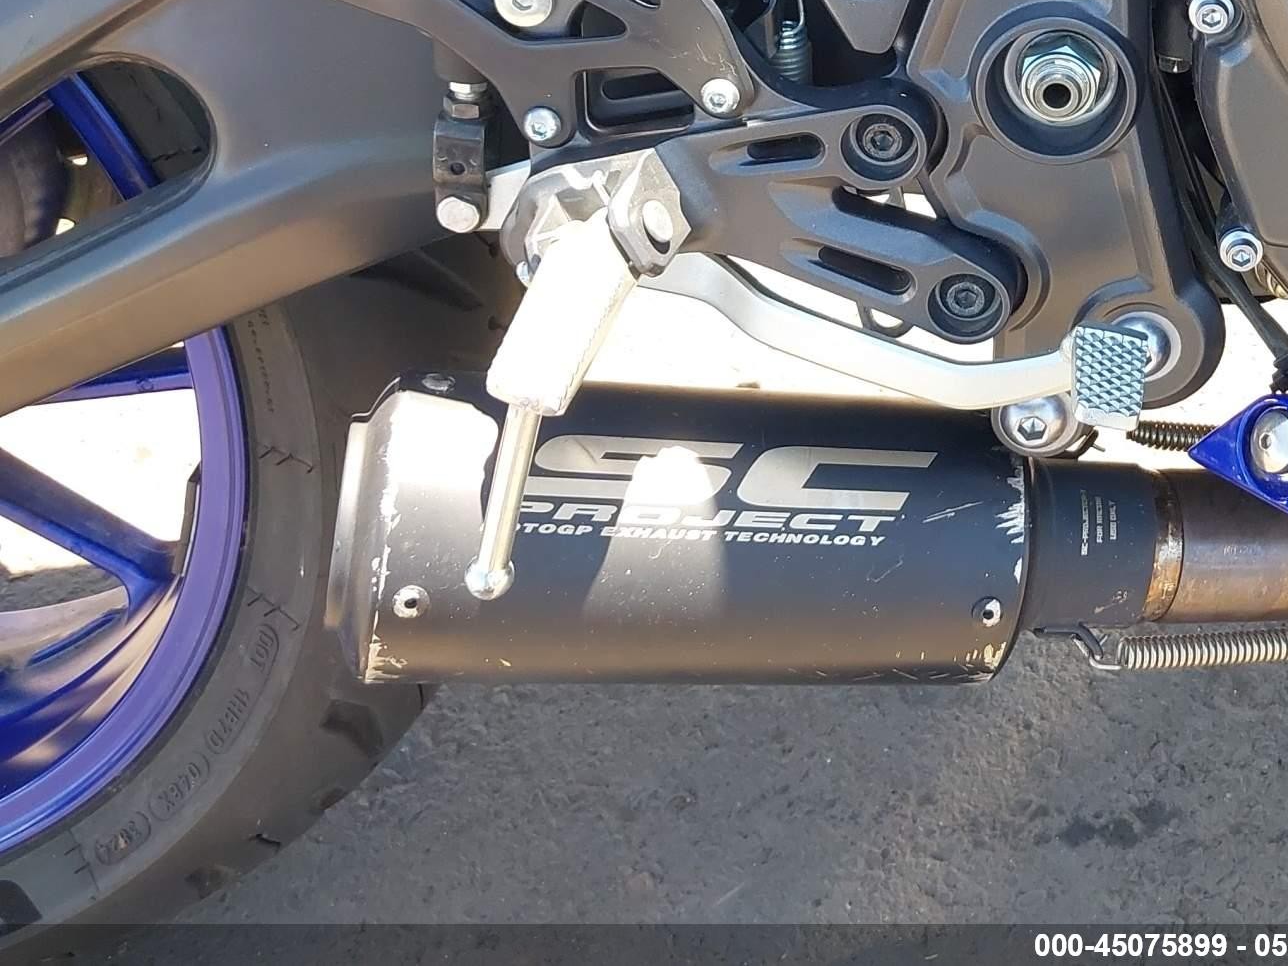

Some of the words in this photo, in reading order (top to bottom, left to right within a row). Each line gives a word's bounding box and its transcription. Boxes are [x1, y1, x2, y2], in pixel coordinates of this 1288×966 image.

[524, 434, 938, 511] SC
[600, 526, 718, 541] EXHAUST
[724, 531, 886, 547] TECHNOLOGY
